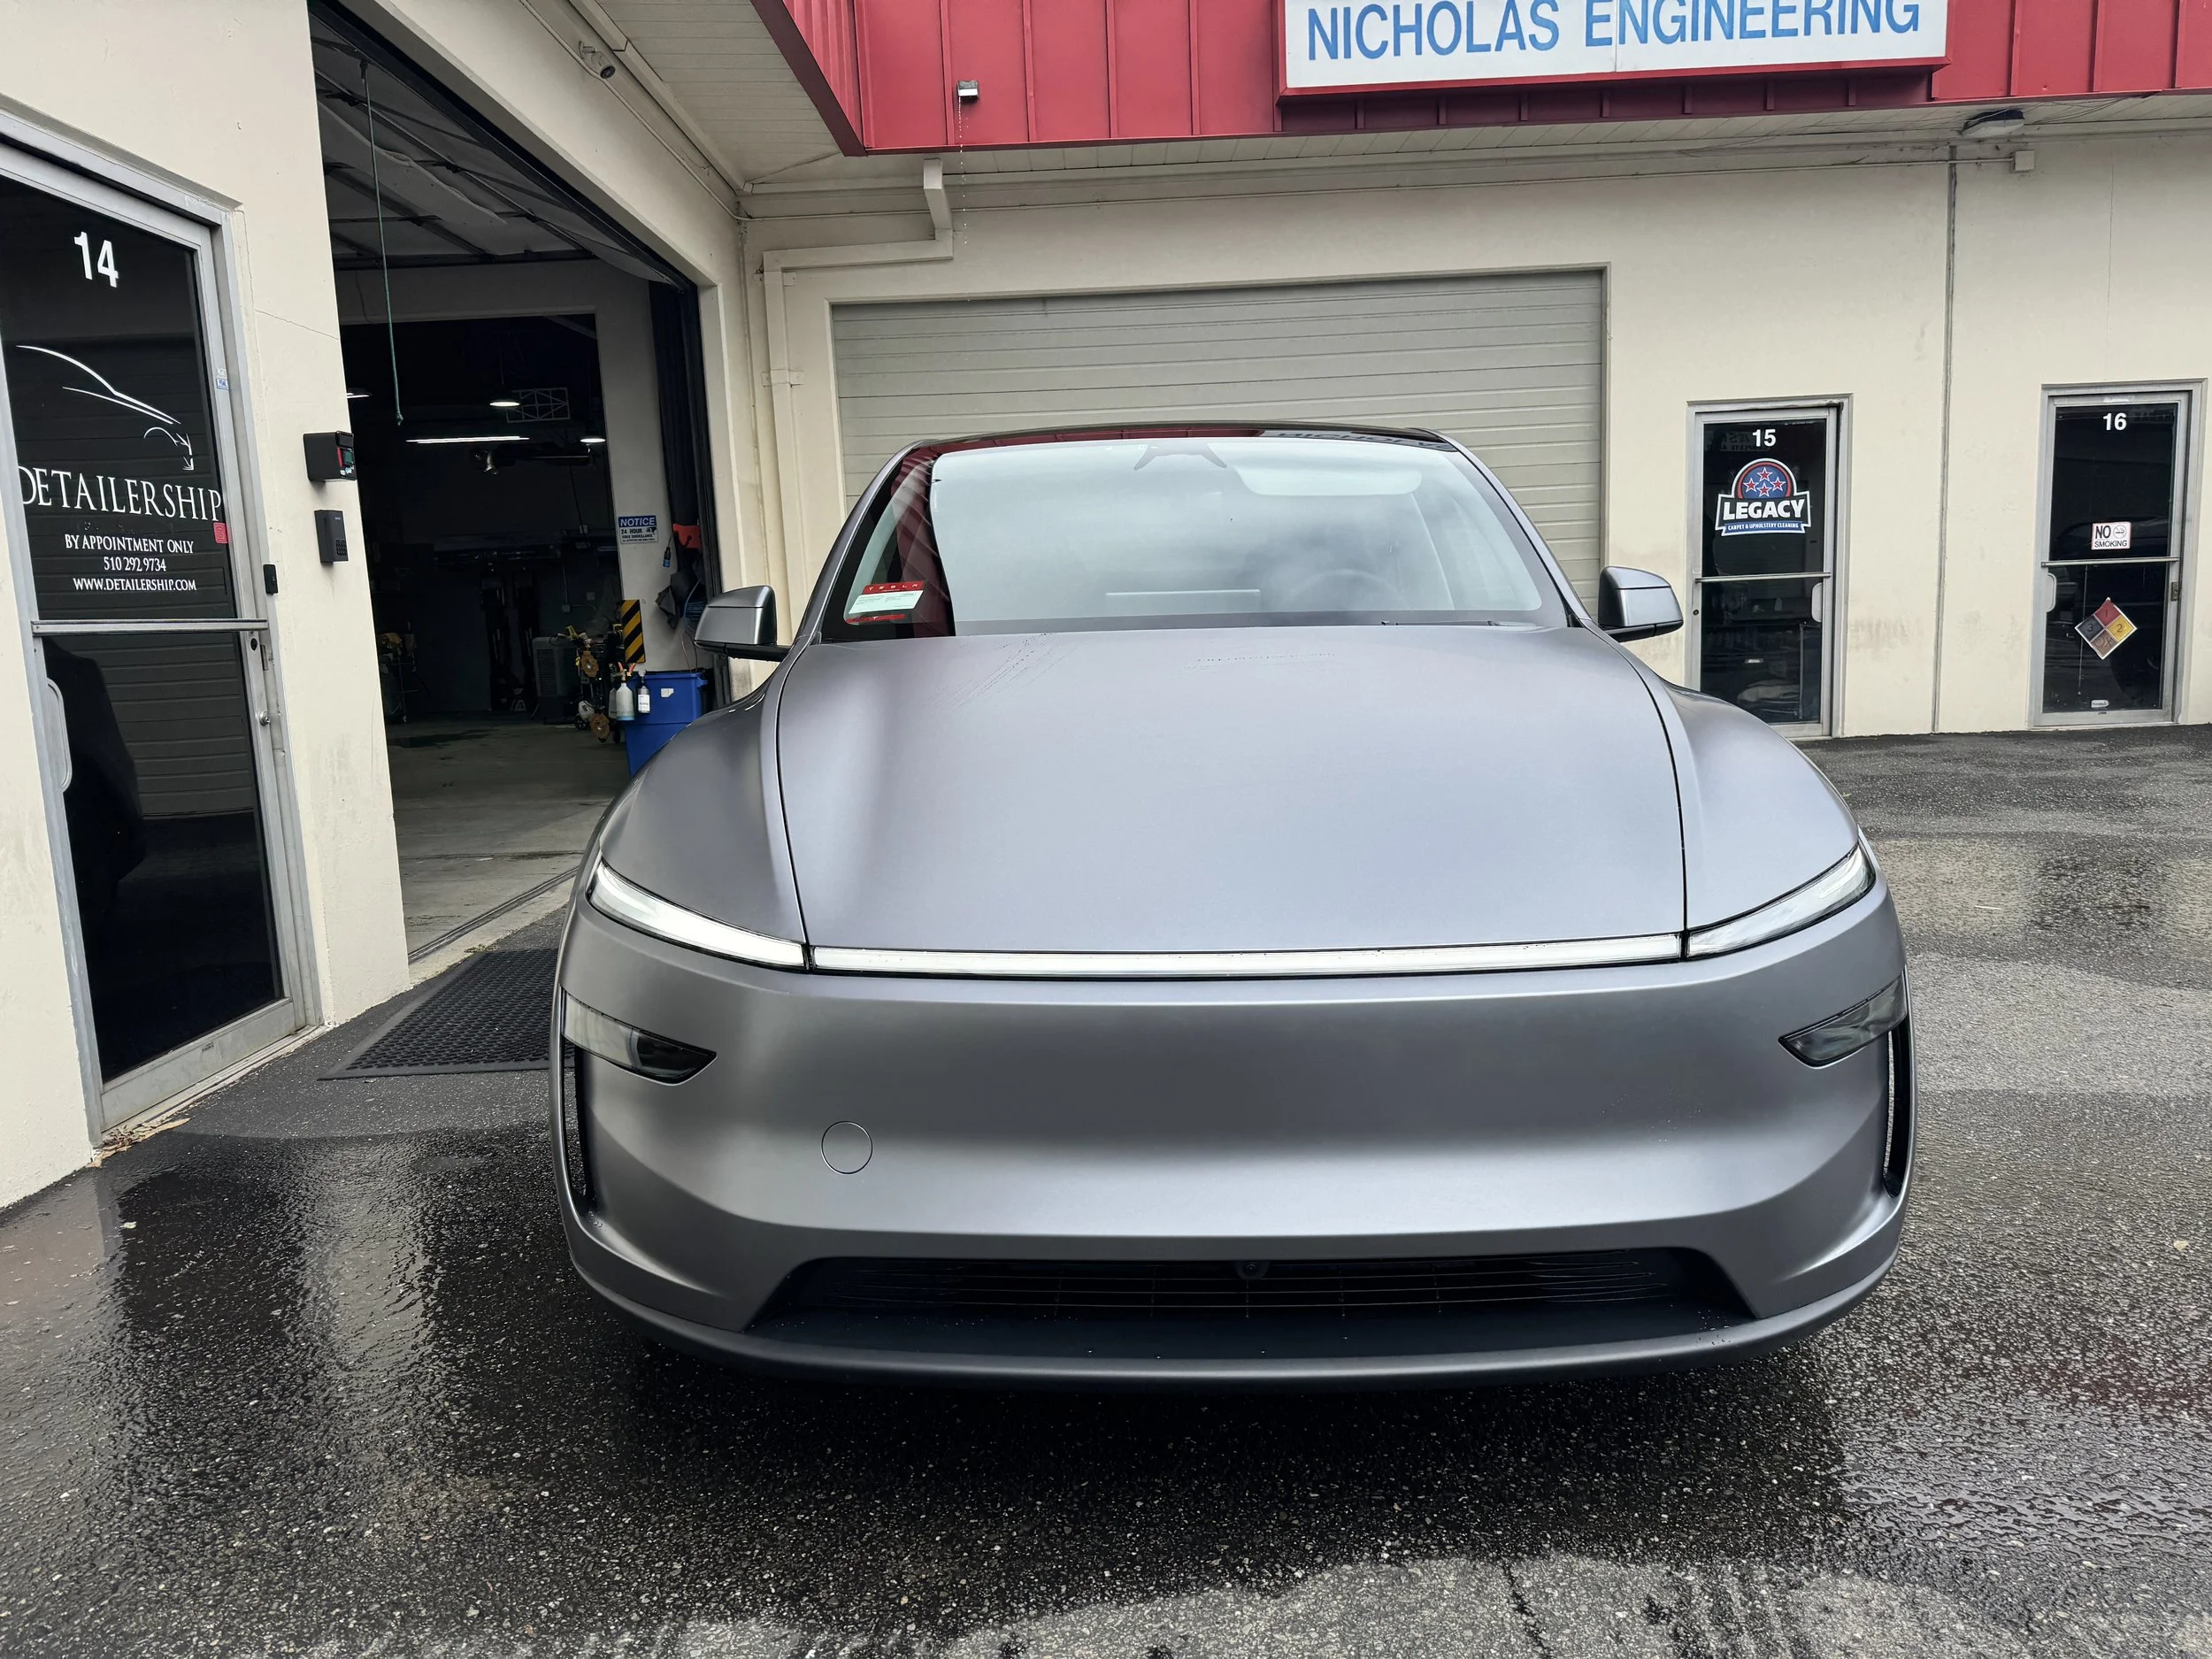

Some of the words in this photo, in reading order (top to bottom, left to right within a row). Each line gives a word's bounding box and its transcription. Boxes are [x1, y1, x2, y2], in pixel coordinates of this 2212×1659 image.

[1308, 0, 1560, 60] NICHOLAS
[1585, 0, 1919, 47] ENGINEERING
[73, 231, 119, 288] 14
[2102, 412, 2127, 431] 16
[1752, 428, 1777, 447] 15
[18, 465, 221, 521] DETAILERSHIP
[1723, 498, 1805, 520] LEGACY
[620, 517, 655, 526] NOTICE
[2095, 525, 2111, 539] NO
[65, 534, 80, 549] BY
[82, 534, 164, 553] APPOINTMENT
[166, 539, 194, 554] ONLY
[104, 557, 122, 571] 510
[123, 557, 142, 572] 292
[142, 558, 166, 572] 9734
[73, 578, 197, 591] WWW.DETAILERSHIP.COM
[2086, 622, 2093, 633] 3
[2116, 623, 2123, 633] 2
